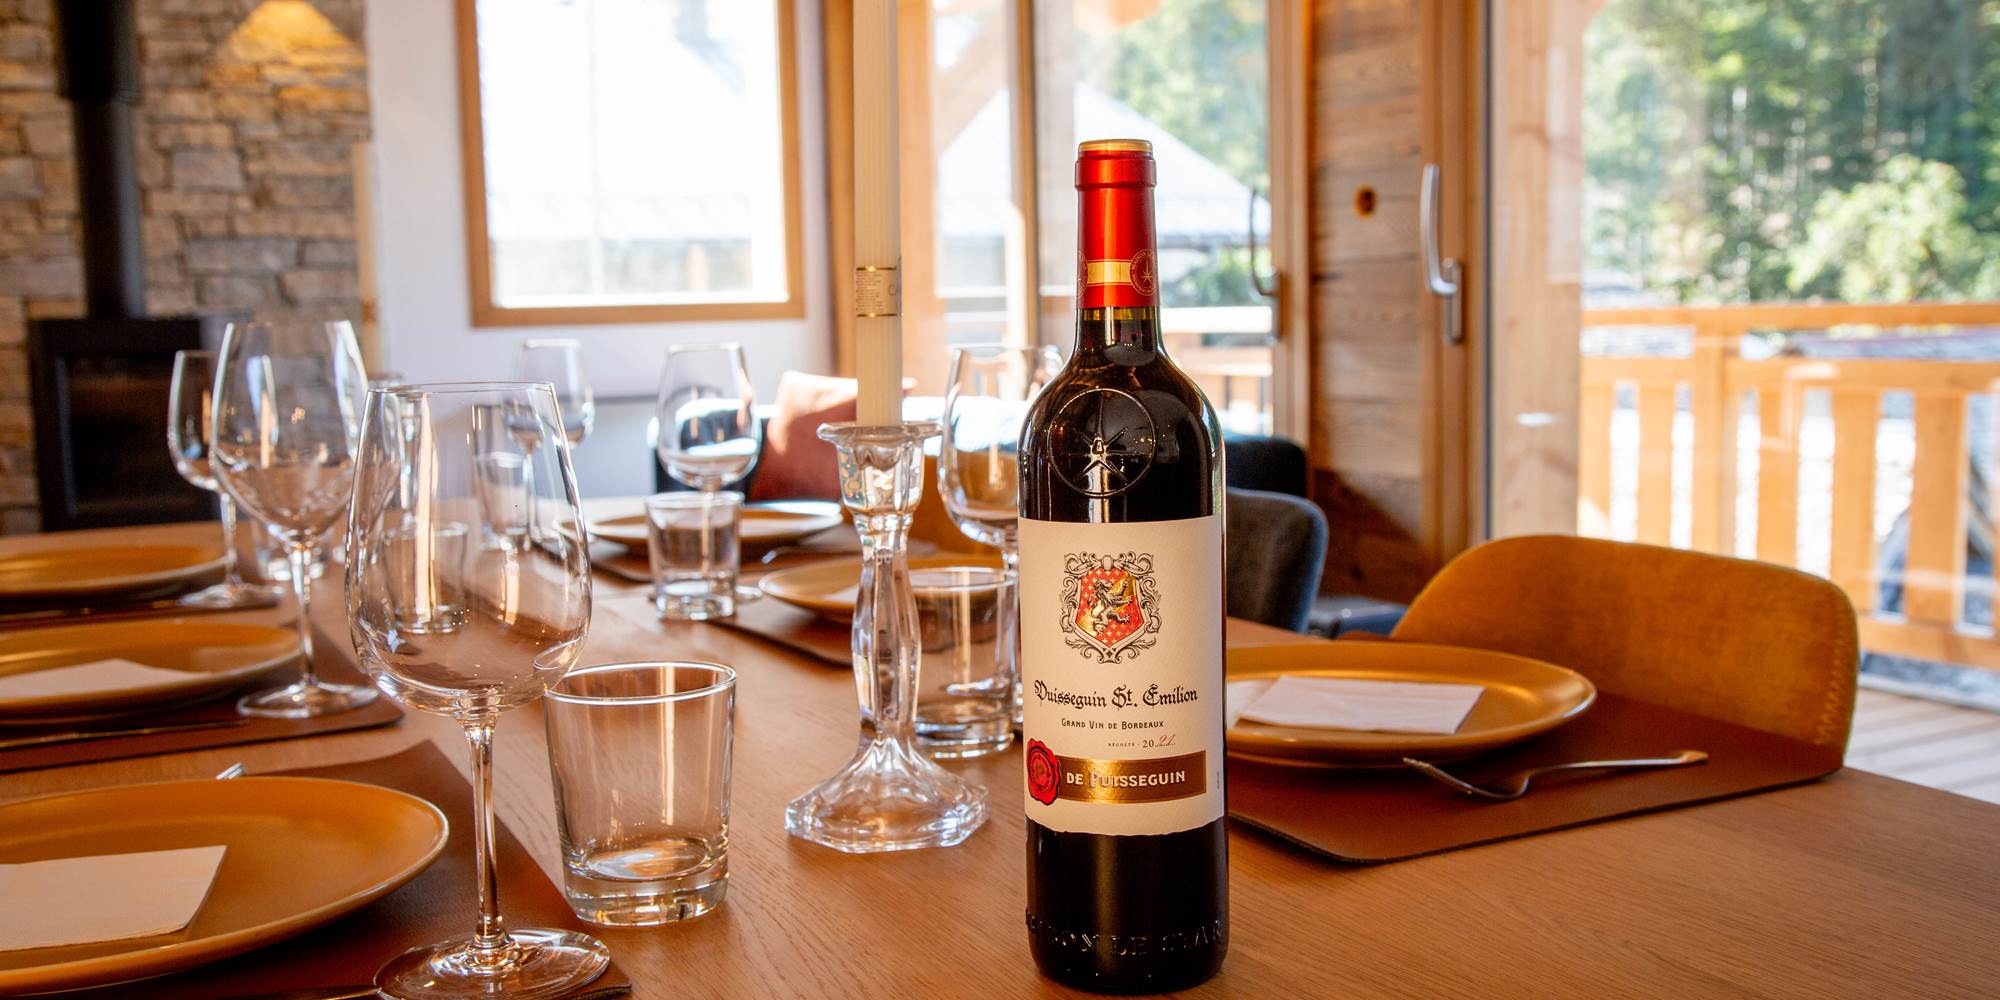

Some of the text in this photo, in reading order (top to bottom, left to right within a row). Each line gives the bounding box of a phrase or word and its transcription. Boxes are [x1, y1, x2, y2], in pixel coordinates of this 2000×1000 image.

[1034, 680, 1107, 709] Puisseguin
[1061, 718, 1086, 728] GRAND
[1089, 720, 1104, 729] VIN
[1121, 720, 1164, 730] BORDEAUX
[1066, 770, 1185, 787] DE PUISSEGUIN
